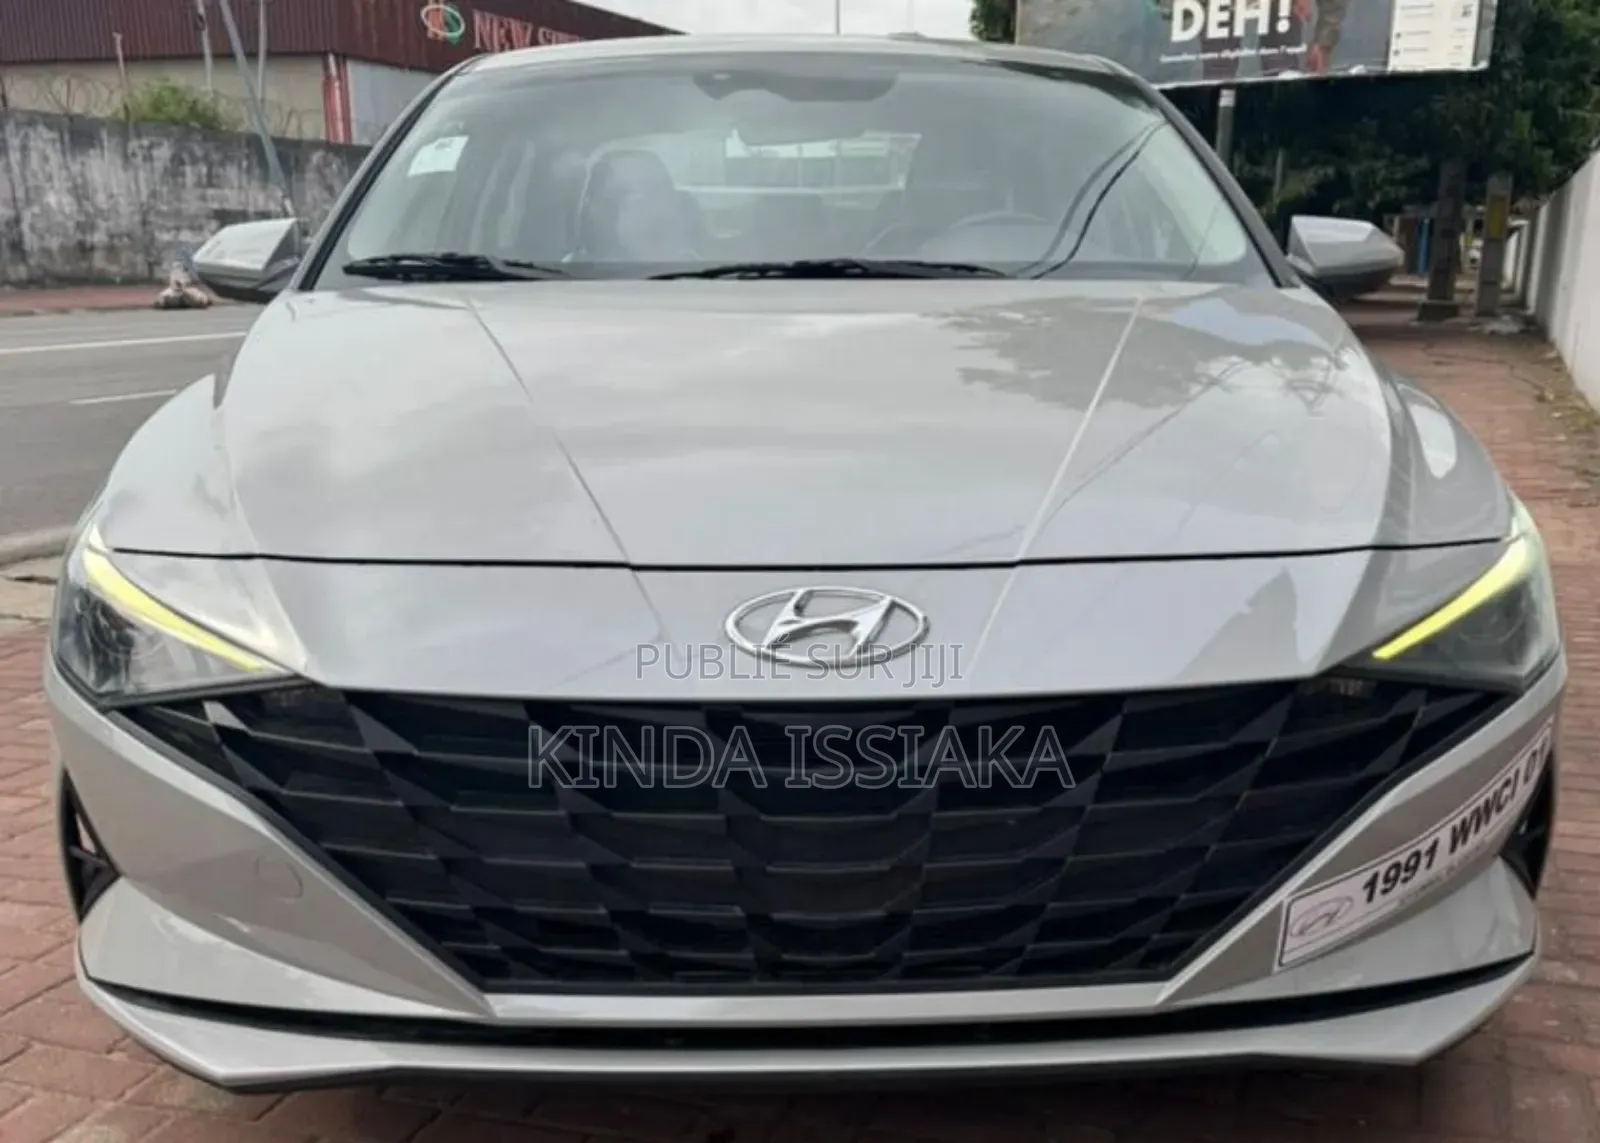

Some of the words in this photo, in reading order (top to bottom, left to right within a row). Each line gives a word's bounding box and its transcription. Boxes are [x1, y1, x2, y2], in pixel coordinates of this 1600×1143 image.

[472, 9, 534, 54] NEW
[1170, 0, 1291, 42] DEH!
[1362, 836, 1440, 904] 1991
[1449, 767, 1521, 856] WWCI
